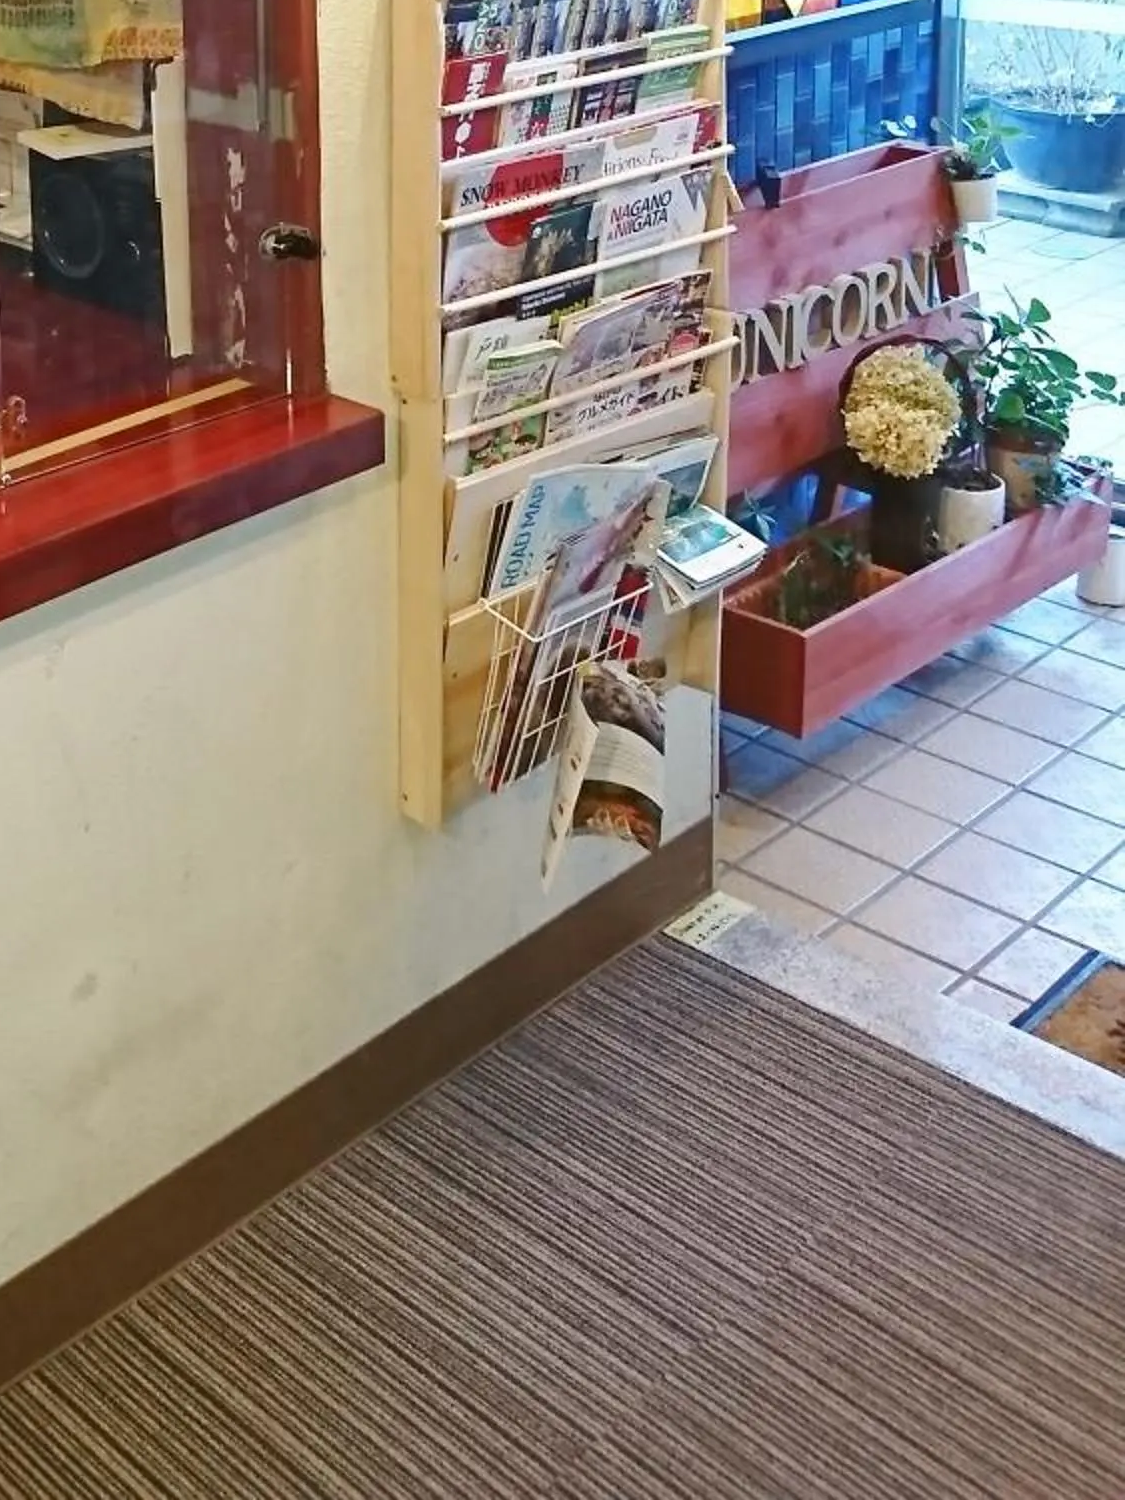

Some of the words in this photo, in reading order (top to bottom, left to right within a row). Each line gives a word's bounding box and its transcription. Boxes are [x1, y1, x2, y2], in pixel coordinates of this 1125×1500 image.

[610, 189, 672, 224] NAGANO
[501, 531, 531, 589] ROAD
[520, 485, 545, 529] MAP
